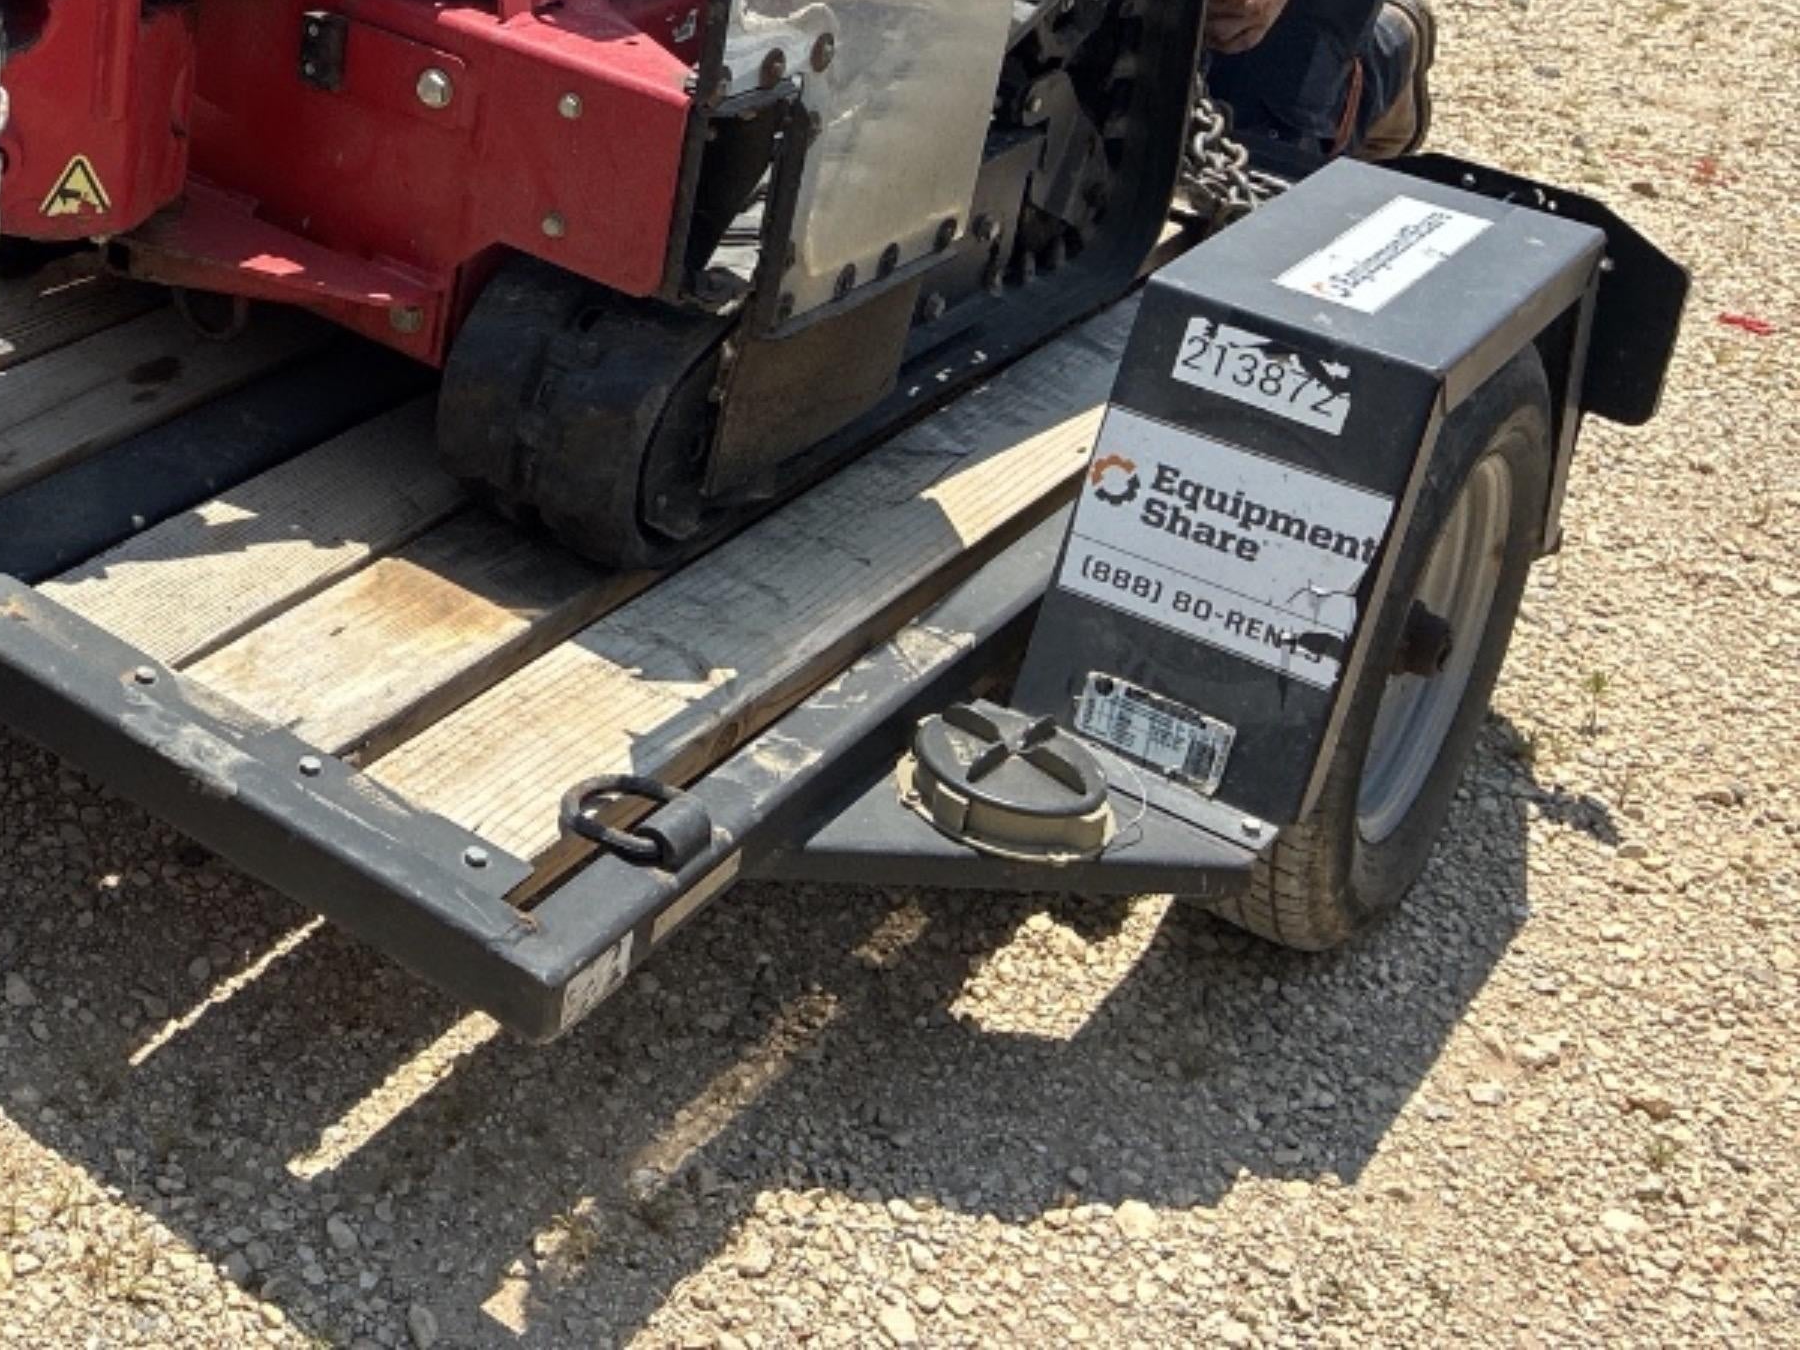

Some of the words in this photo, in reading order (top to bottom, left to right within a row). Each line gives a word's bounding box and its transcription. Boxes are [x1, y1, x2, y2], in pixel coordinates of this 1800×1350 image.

[1180, 334, 1338, 419] 213872
[1140, 496, 1262, 562] Share
[1150, 462, 1380, 564] Equipment
[1081, 554, 1163, 605] (888)
